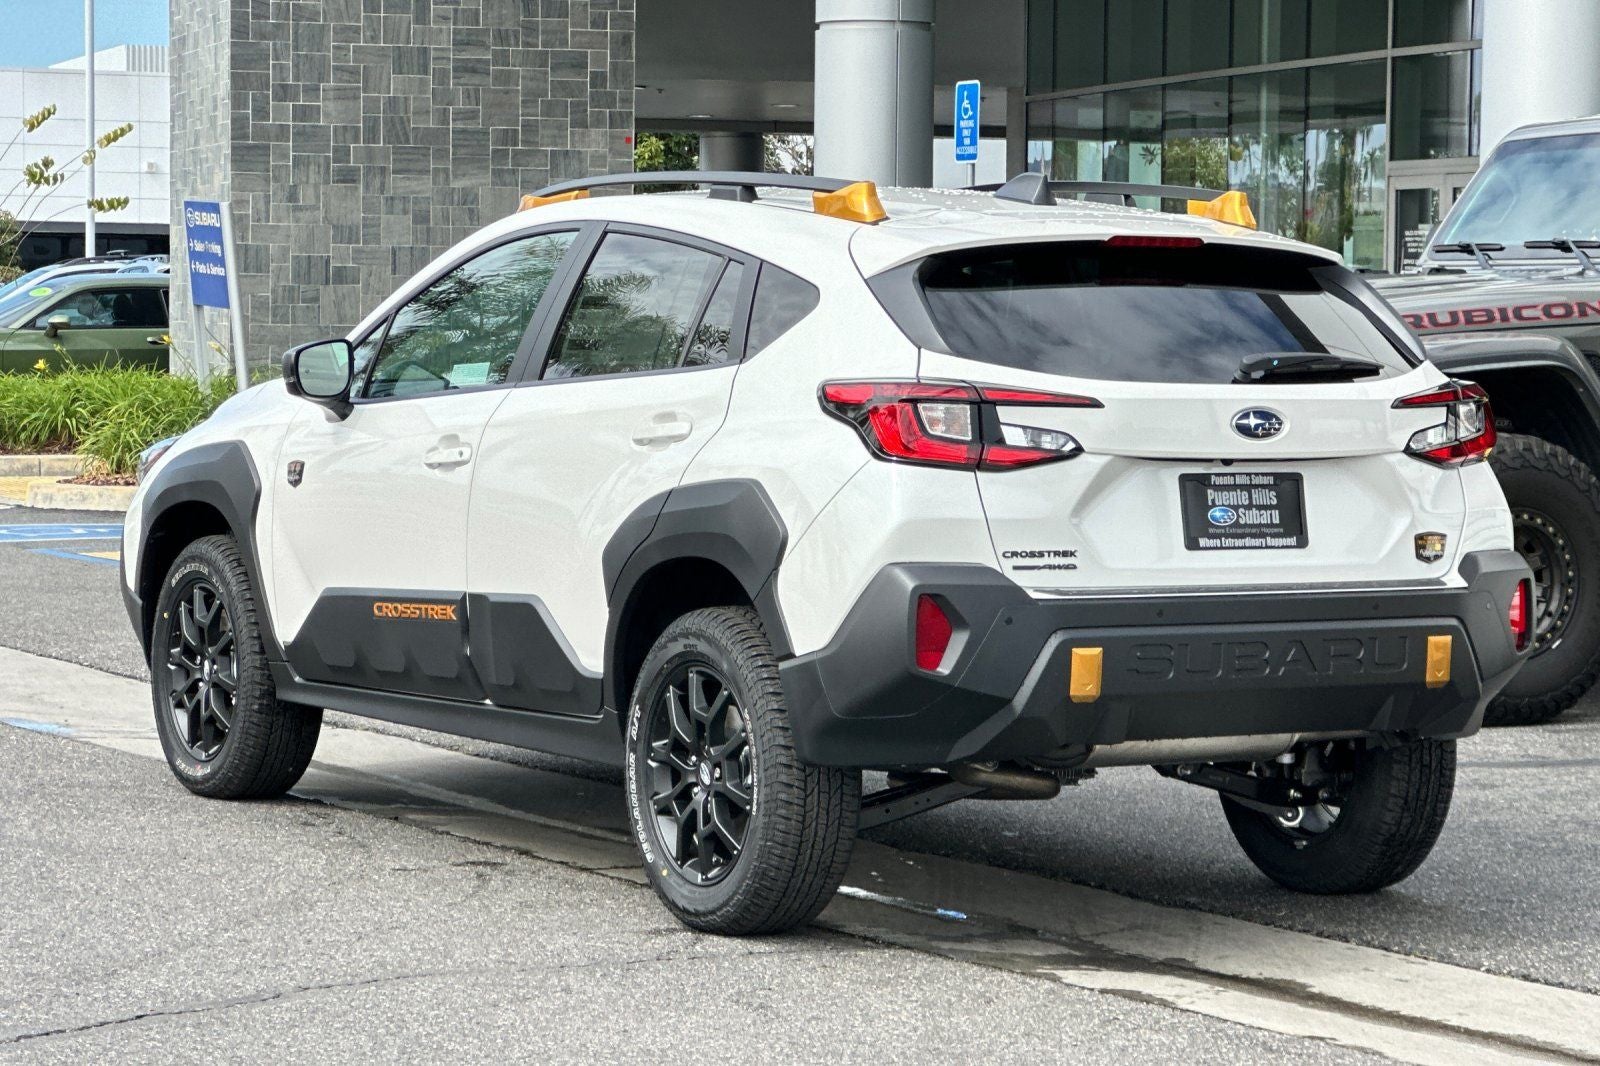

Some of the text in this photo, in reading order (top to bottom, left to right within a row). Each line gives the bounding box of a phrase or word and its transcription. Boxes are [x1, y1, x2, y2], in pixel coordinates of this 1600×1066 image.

[194, 211, 220, 227] SUBARU
[196, 261, 207, 274] Parts
[210, 263, 225, 276] Service
[1211, 474, 1274, 485] Puente Hills Subaru
[1207, 488, 1277, 506] Puente Hills
[1238, 508, 1280, 524] Subaru
[1199, 536, 1297, 548] Where Extraordinary Happens!
[1002, 550, 1078, 559] CROSSTREK
[373, 602, 457, 620] CROSSTREK
[1127, 636, 1409, 681] SUBARU
[626, 752, 654, 863] GEOLANDAR
